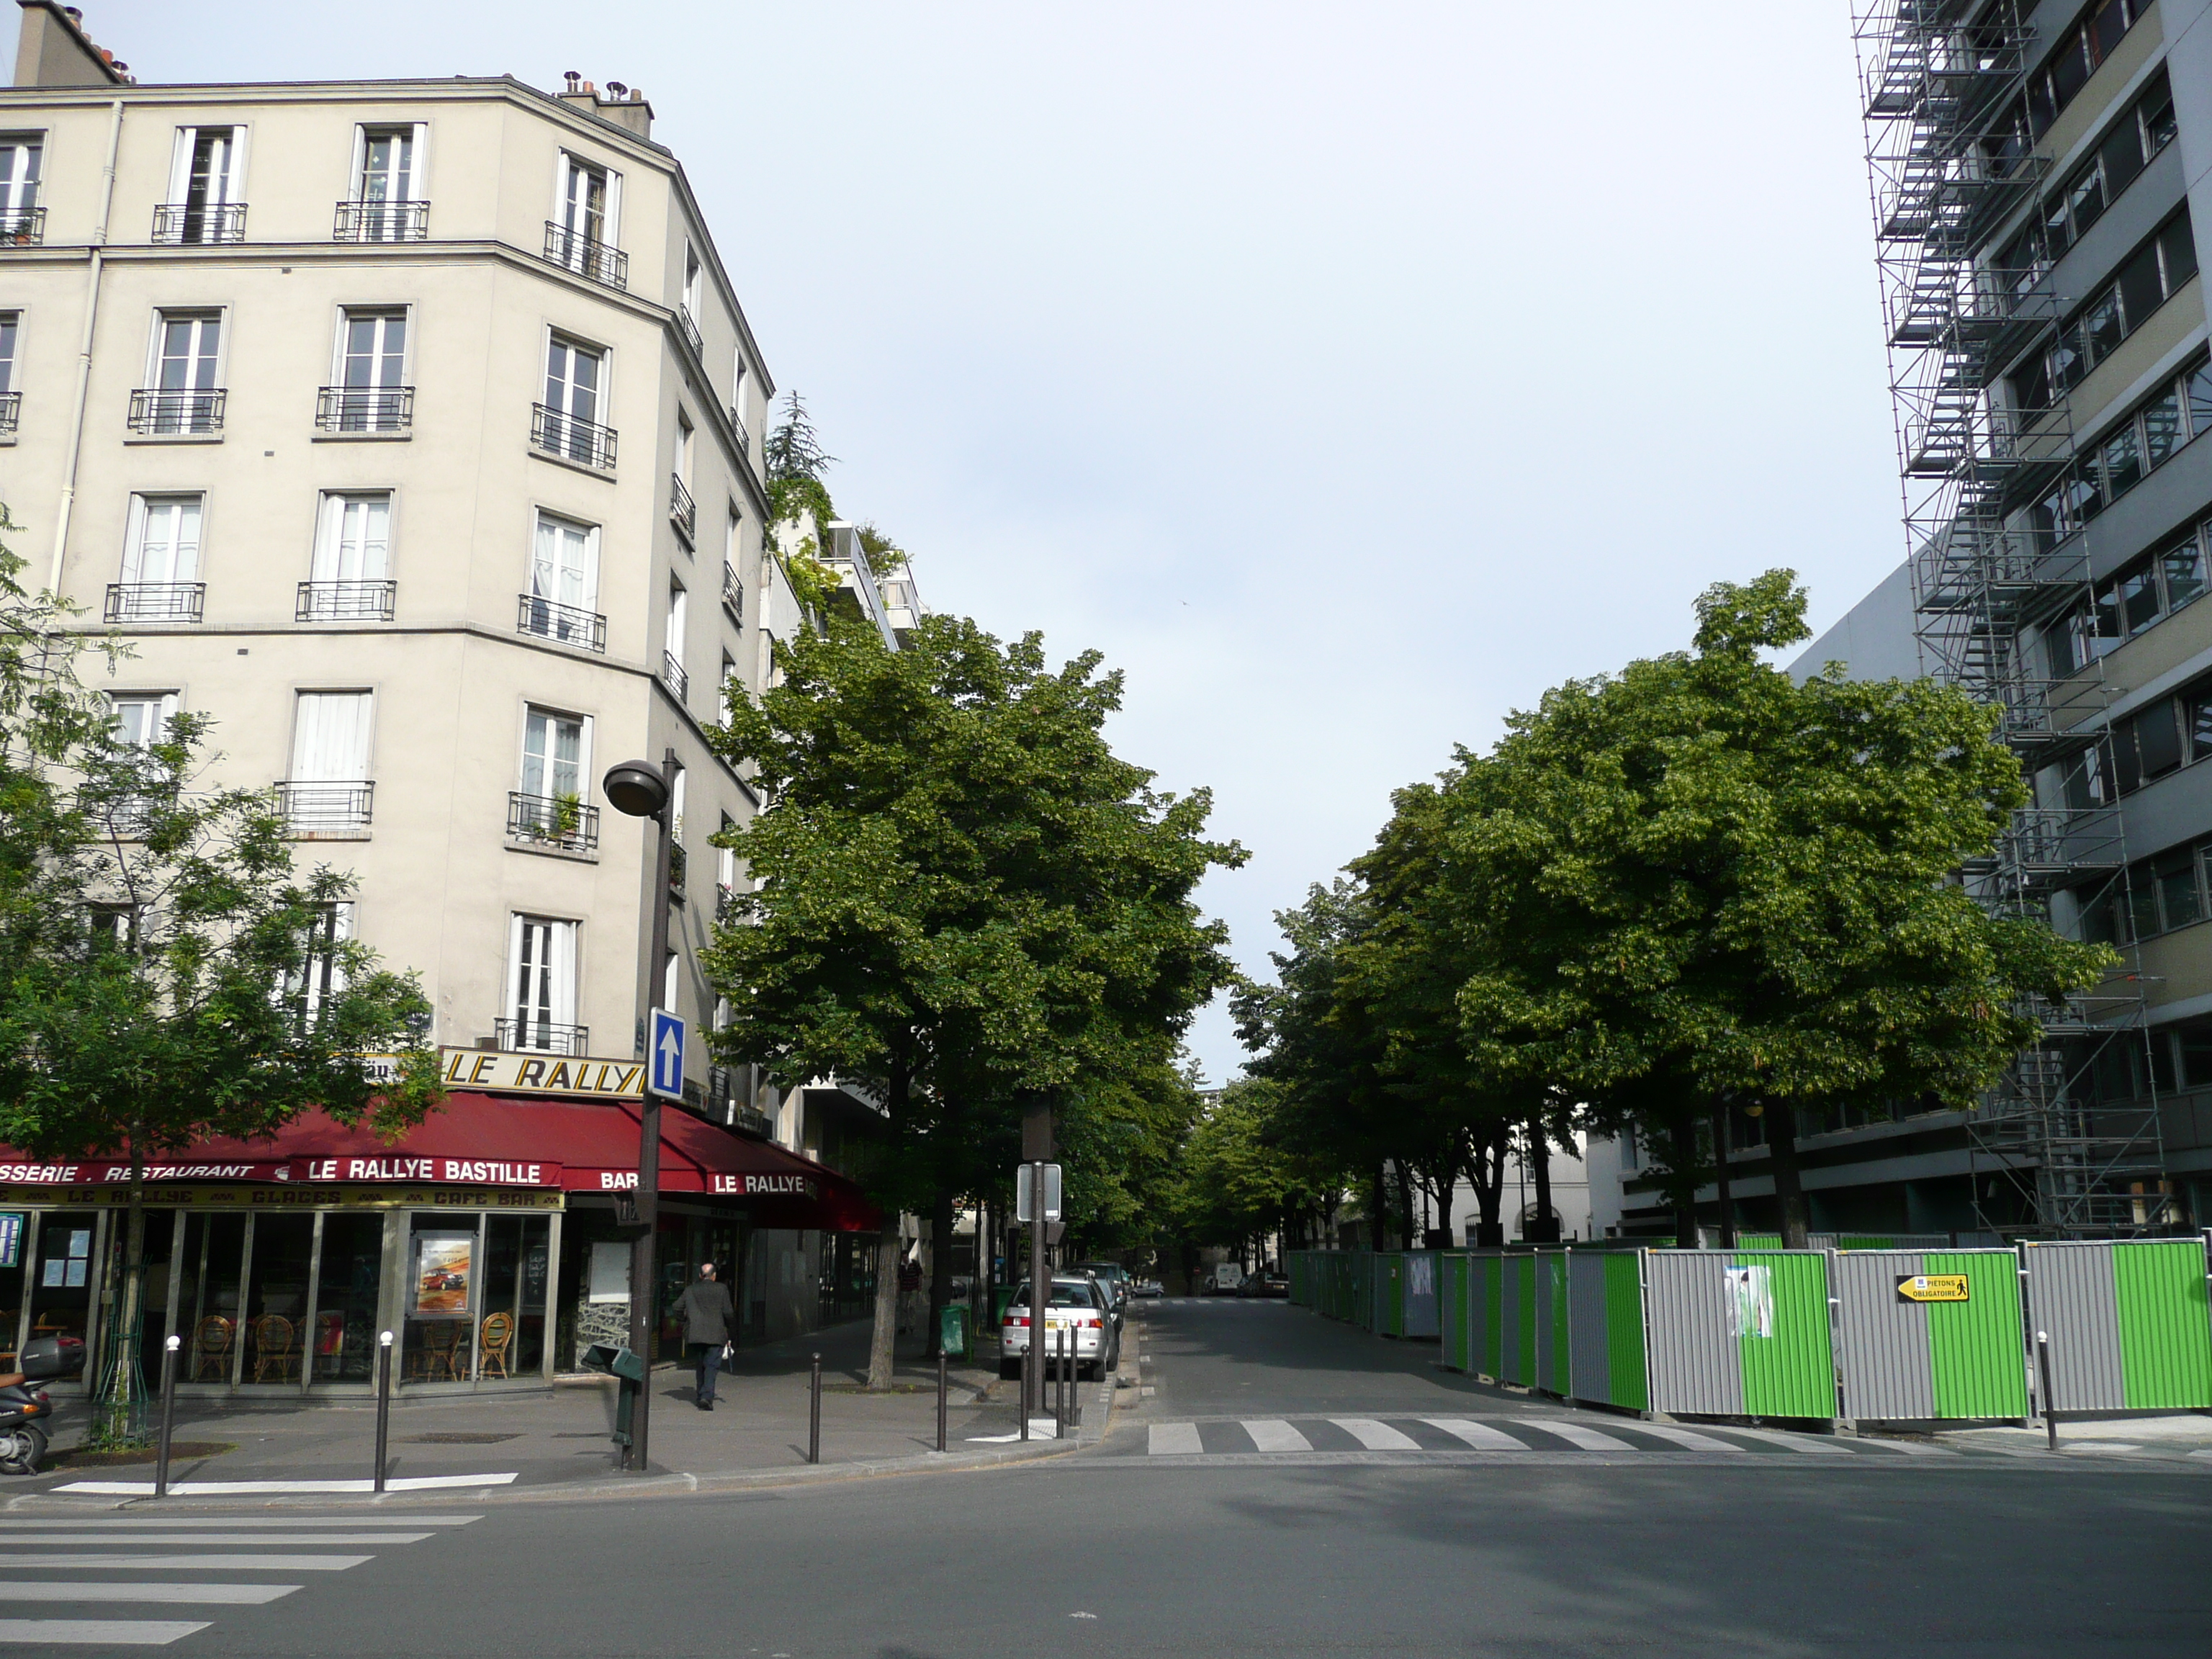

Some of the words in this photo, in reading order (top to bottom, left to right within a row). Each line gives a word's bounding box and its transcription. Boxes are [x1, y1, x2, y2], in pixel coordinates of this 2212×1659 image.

[445, 1053, 498, 1084] LE
[104, 1165, 255, 1181] RESTAURANT
[309, 1161, 337, 1179] LE
[349, 1159, 433, 1179] RALLYE
[445, 1161, 540, 1183] BASTILLE
[601, 1172, 639, 1189] BAR
[715, 1175, 737, 1193] LE
[745, 1176, 804, 1193] RALLYE
[67, 1190, 95, 1202] LE
[252, 1190, 341, 1204] GLACES
[434, 1192, 487, 1205] CAFE
[498, 1193, 536, 1206] BAR
